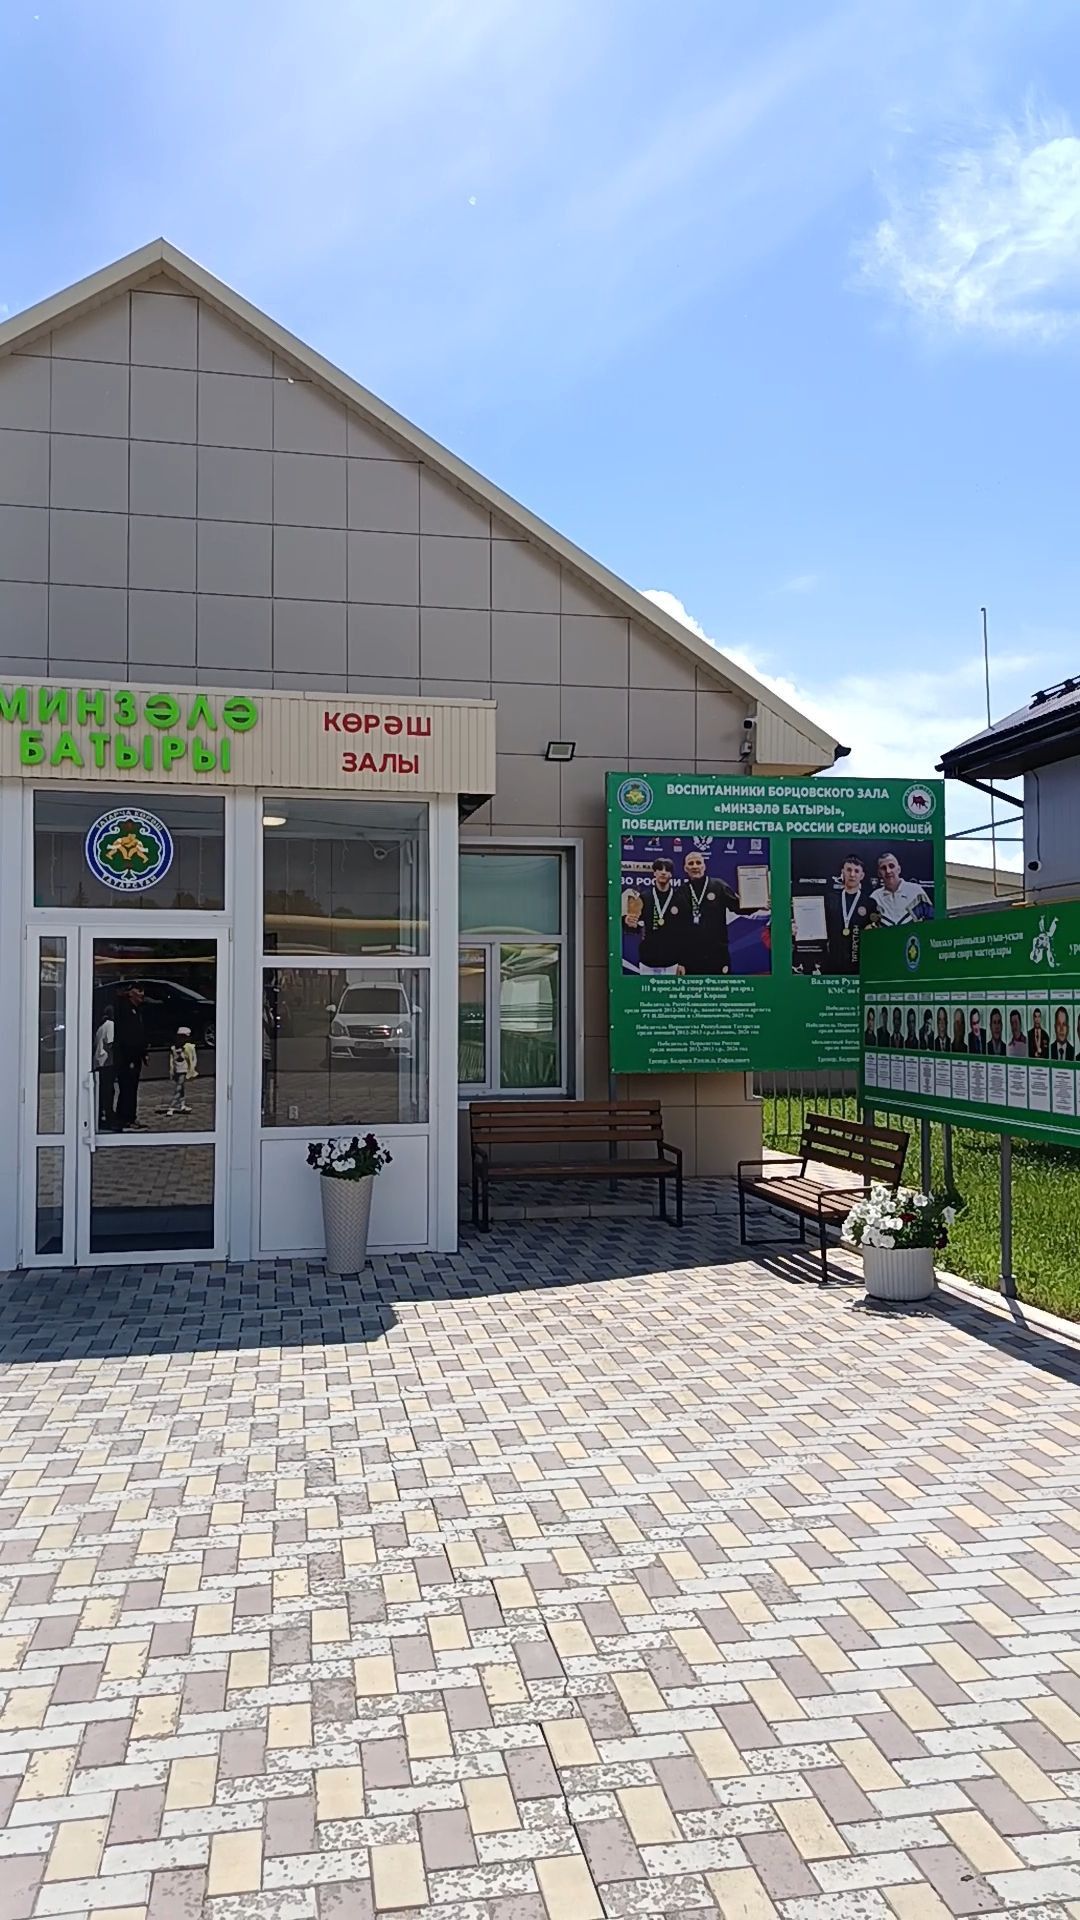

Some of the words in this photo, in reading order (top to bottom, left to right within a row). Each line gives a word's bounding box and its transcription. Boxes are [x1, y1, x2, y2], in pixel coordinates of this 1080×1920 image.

[0, 687, 258, 732] МИНЗӘЛӘ
[324, 711, 431, 737] КӨРӘШ
[19, 730, 231, 773] БАТЫРЫ
[341, 752, 419, 774] ЗАЛЫ
[666, 784, 765, 797] ВОСПИТАННИКИ
[768, 786, 855, 799] БОРЦОВСКОГО
[857, 788, 889, 799] ЗАЛА
[622, 819, 703, 831] ПОБЕДИТЕЛИ
[707, 820, 783, 832] ПЕРВЕНСТВА
[787, 822, 834, 832] РОССИИ
[837, 822, 876, 834] СРЕДИ
[879, 821, 932, 834] ЮНОШЕЙ
